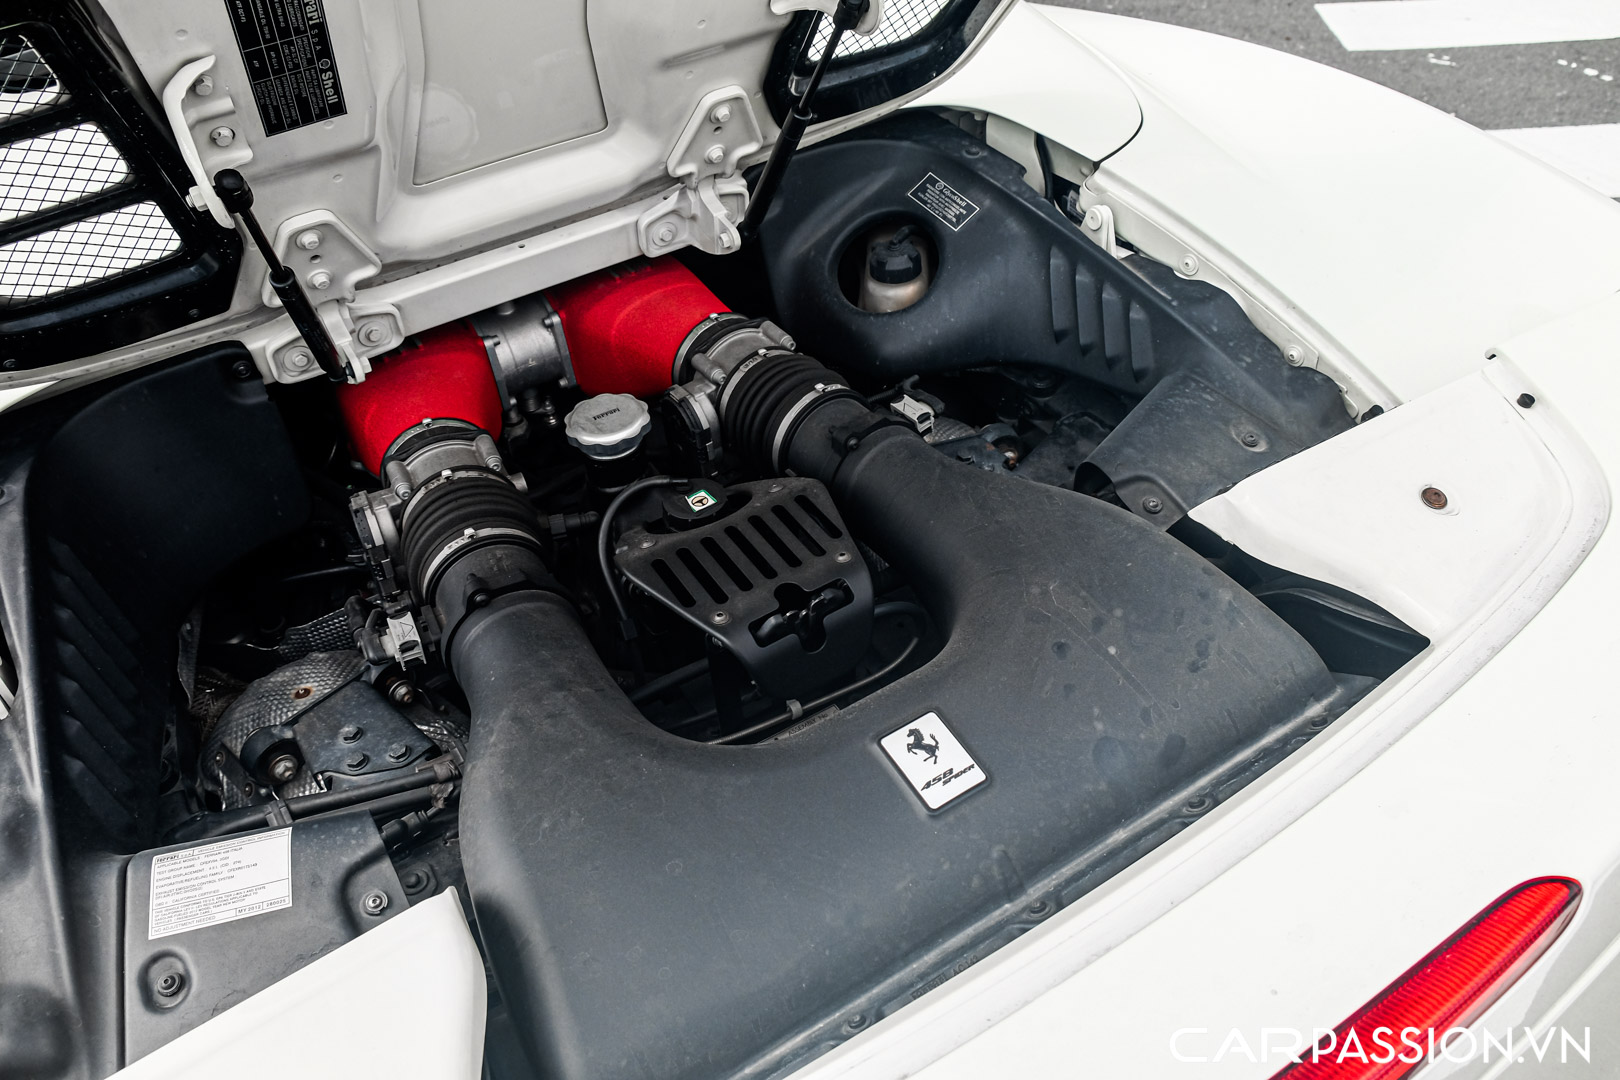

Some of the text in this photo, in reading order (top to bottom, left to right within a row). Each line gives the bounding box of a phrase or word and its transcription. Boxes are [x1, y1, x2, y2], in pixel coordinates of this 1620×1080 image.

[322, 71, 338, 104] Shell
[788, 718, 816, 736] ASSEMBLY
[921, 767, 954, 791] 458
[942, 763, 975, 786] SPIDER
[162, 920, 195, 931] ADJUSTMENT
[196, 915, 215, 923] NEEDED
